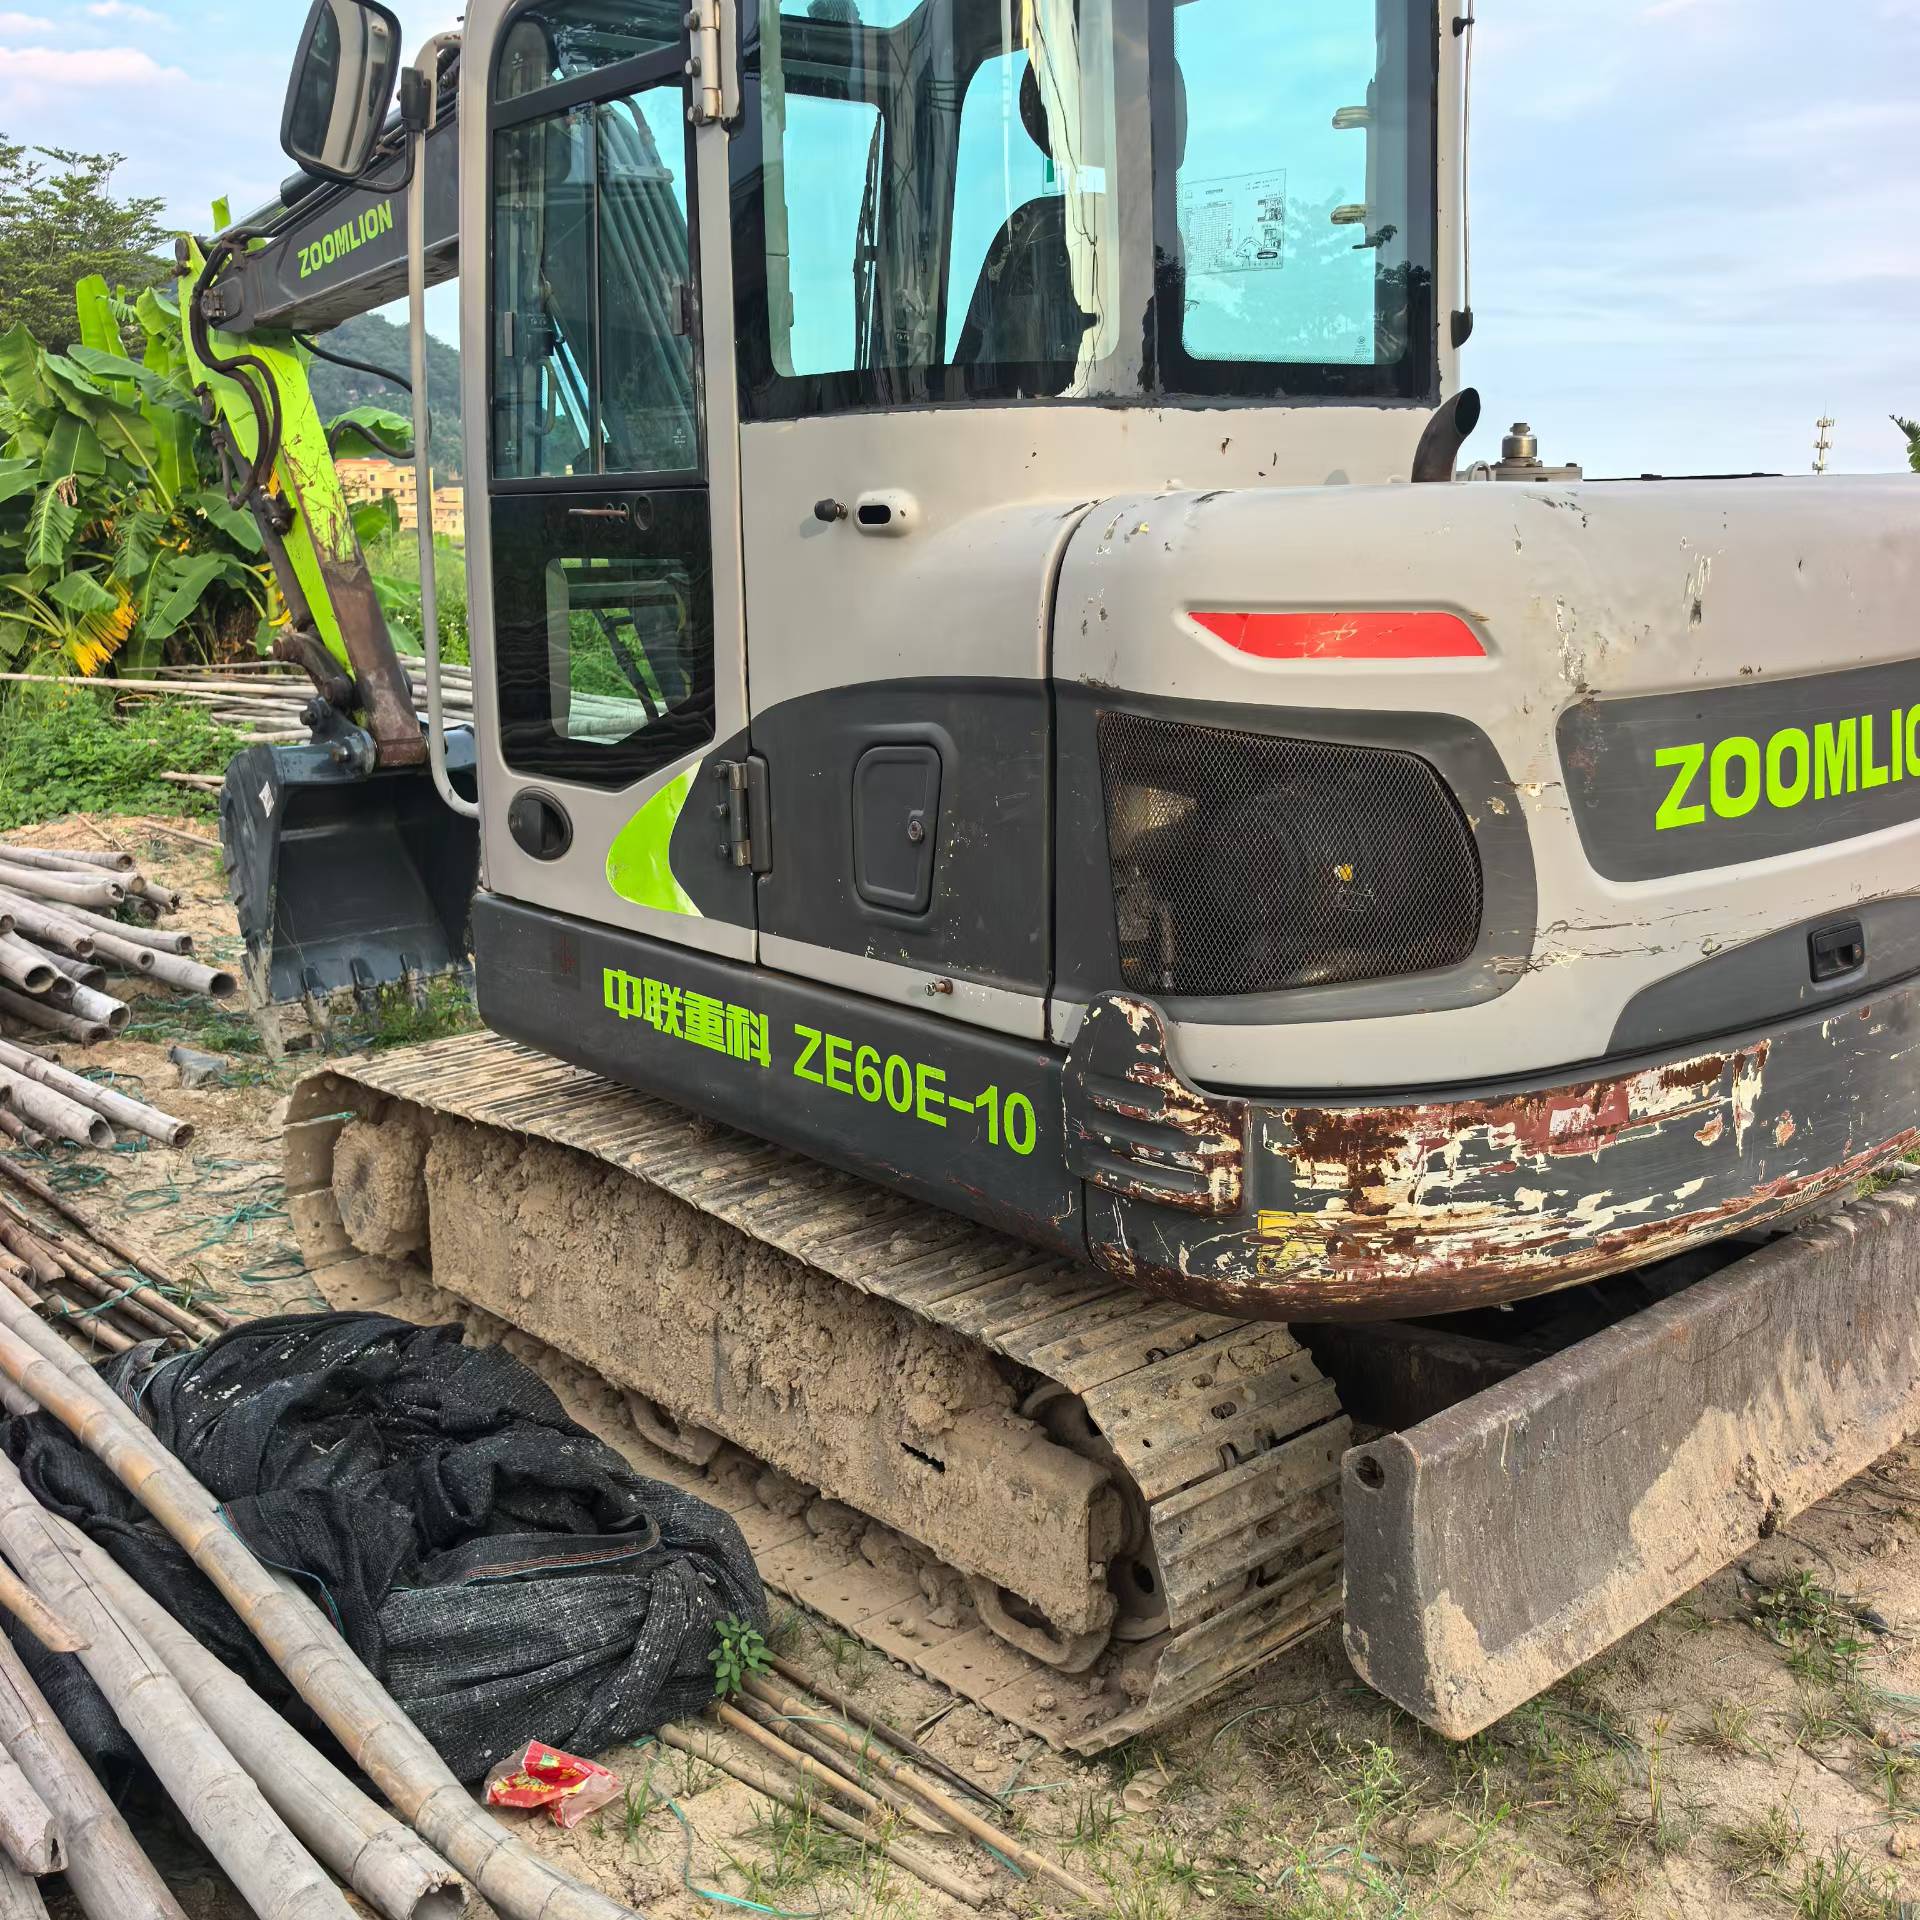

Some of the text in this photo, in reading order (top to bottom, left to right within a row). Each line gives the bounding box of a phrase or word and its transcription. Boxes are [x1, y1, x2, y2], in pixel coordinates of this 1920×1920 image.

[298, 199, 393, 279] ZOOMLION
[602, 967, 1037, 1156] 中联重科 ZE60E-10
